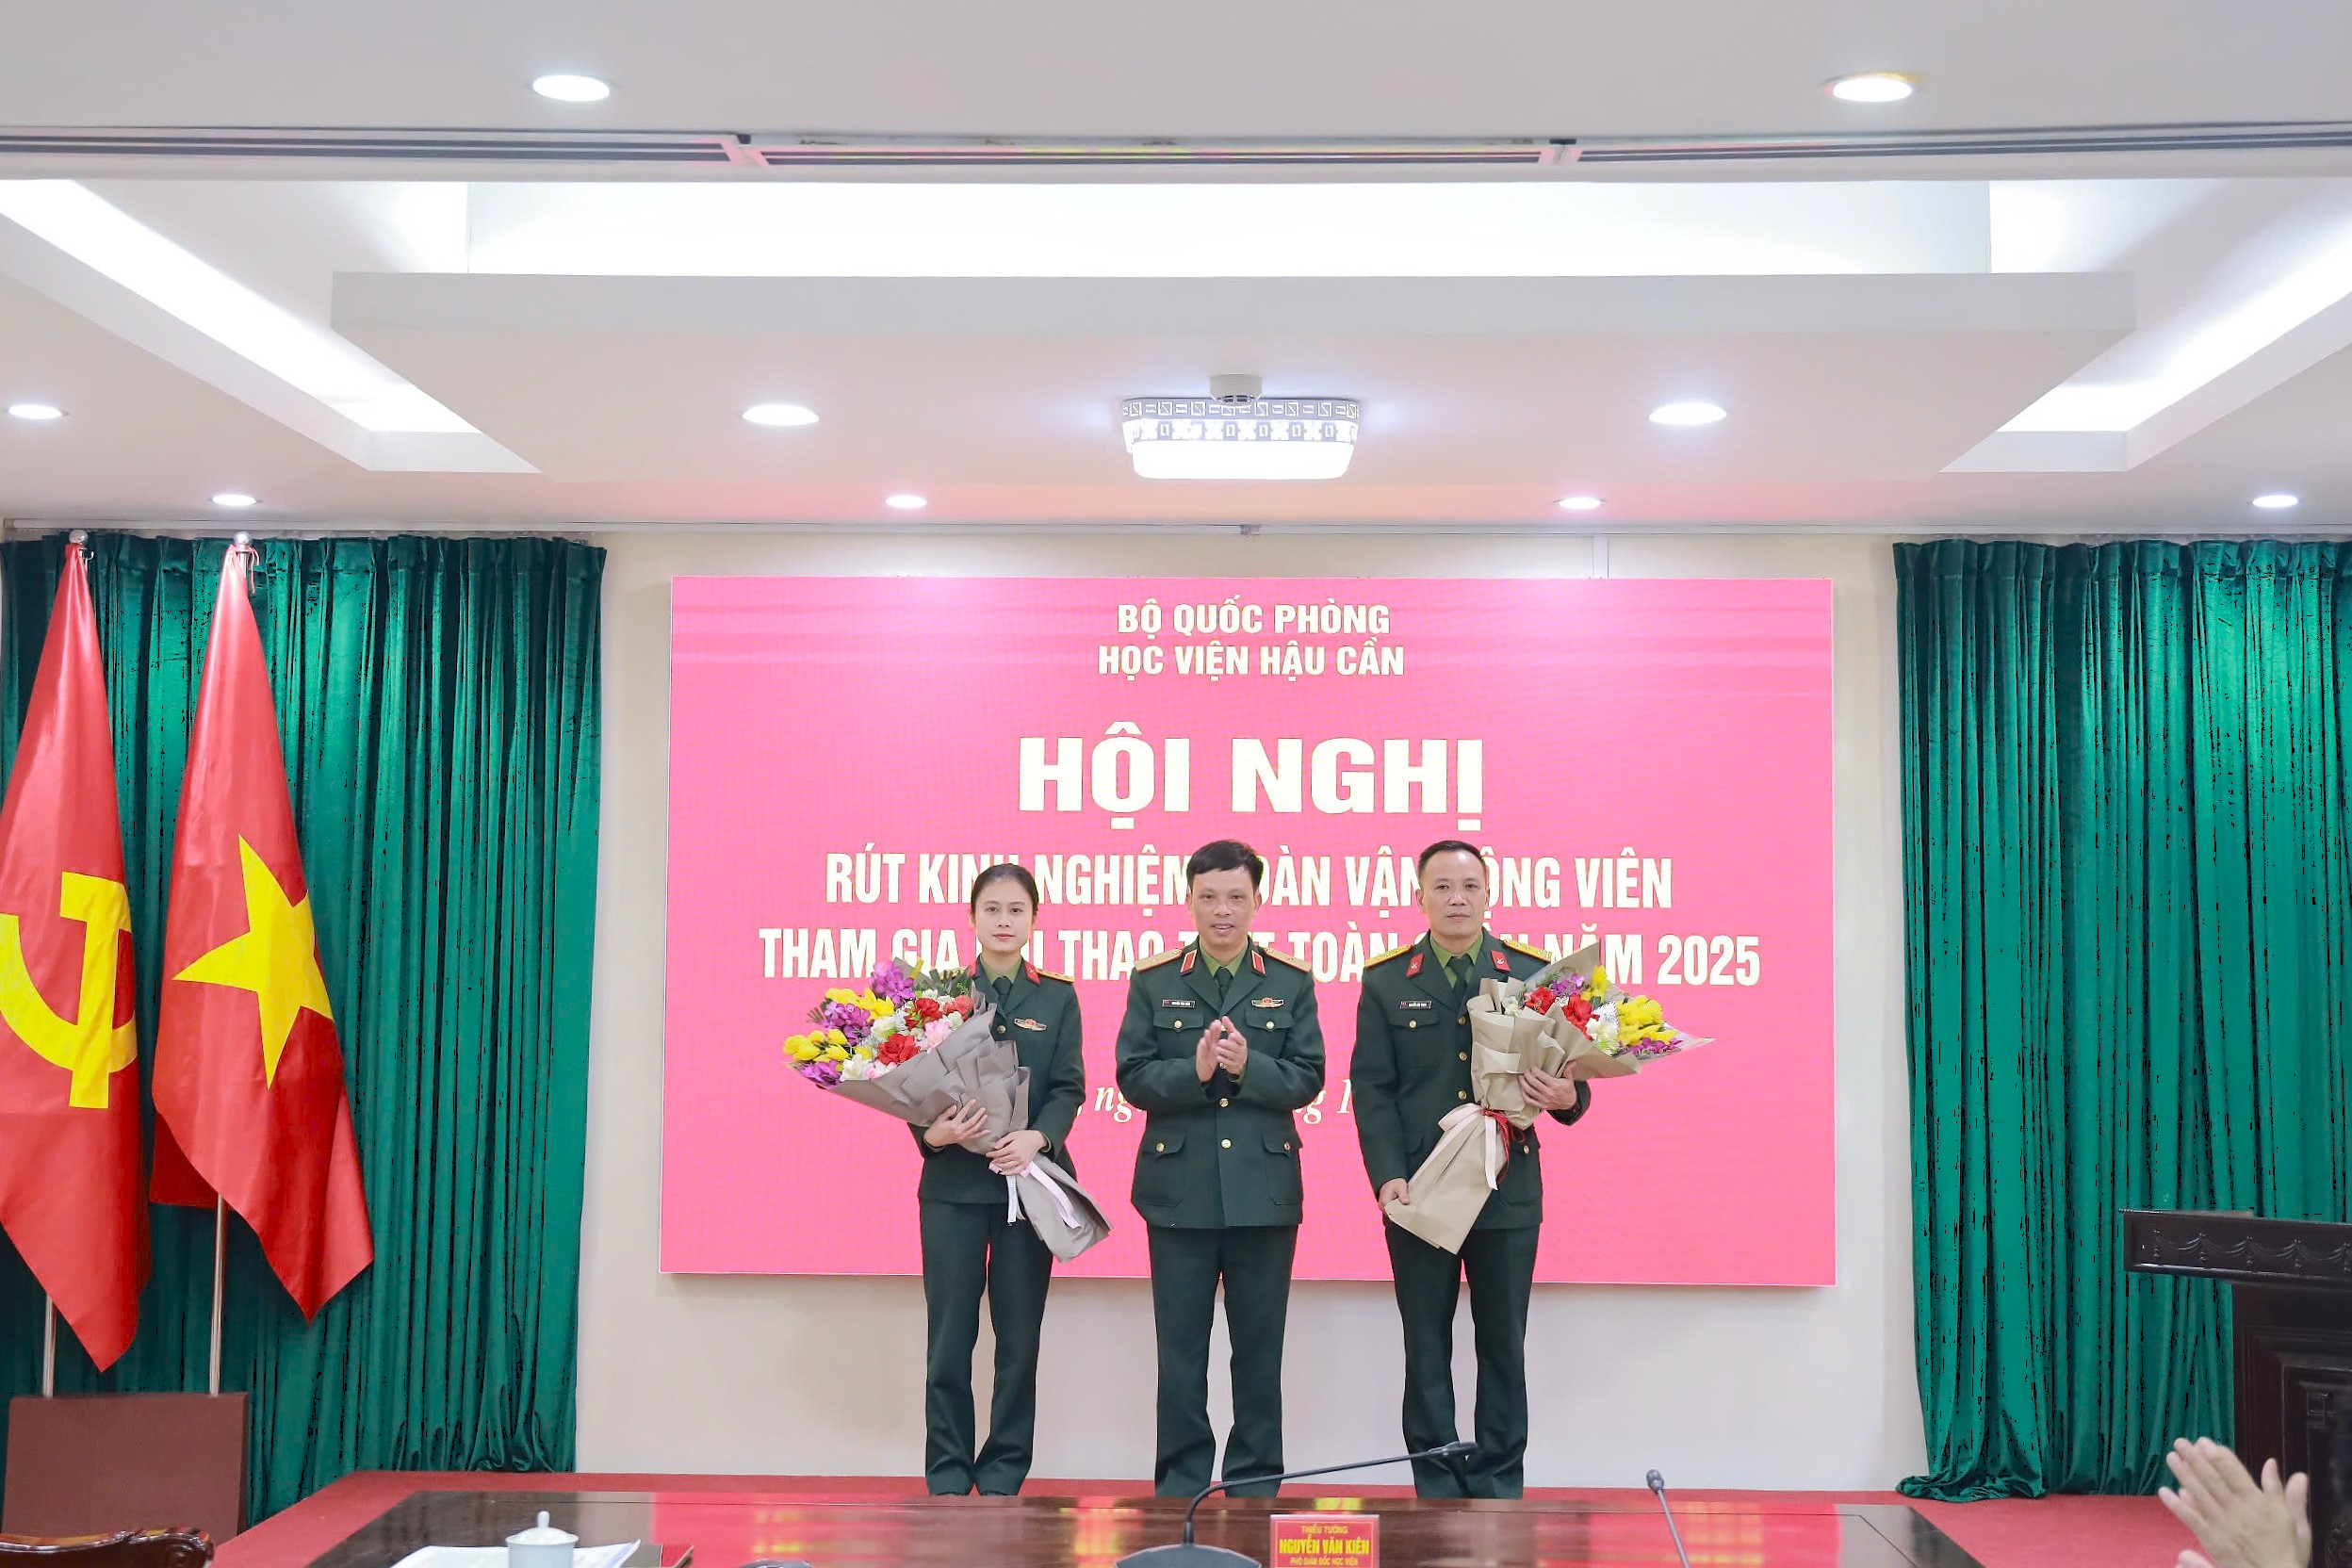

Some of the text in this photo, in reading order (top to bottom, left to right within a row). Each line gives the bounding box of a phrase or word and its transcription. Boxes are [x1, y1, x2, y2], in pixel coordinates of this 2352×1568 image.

[1117, 595, 1391, 639] BỘ QUỐC PHÒNG
[1098, 636, 1405, 682] HỌC VIỆN HẬU CẦN
[1019, 721, 1484, 832] HỘI NGHỊ
[825, 841, 906, 905] RÚT
[918, 852, 1020, 905] KIN
[1479, 845, 1560, 919] ỘNG
[1575, 847, 1674, 909] VIÊN
[759, 928, 877, 979] THAM
[1657, 935, 1761, 987] 2025
[1279, 1534, 1370, 1555] NGUYỄN VĂN KIÊN
